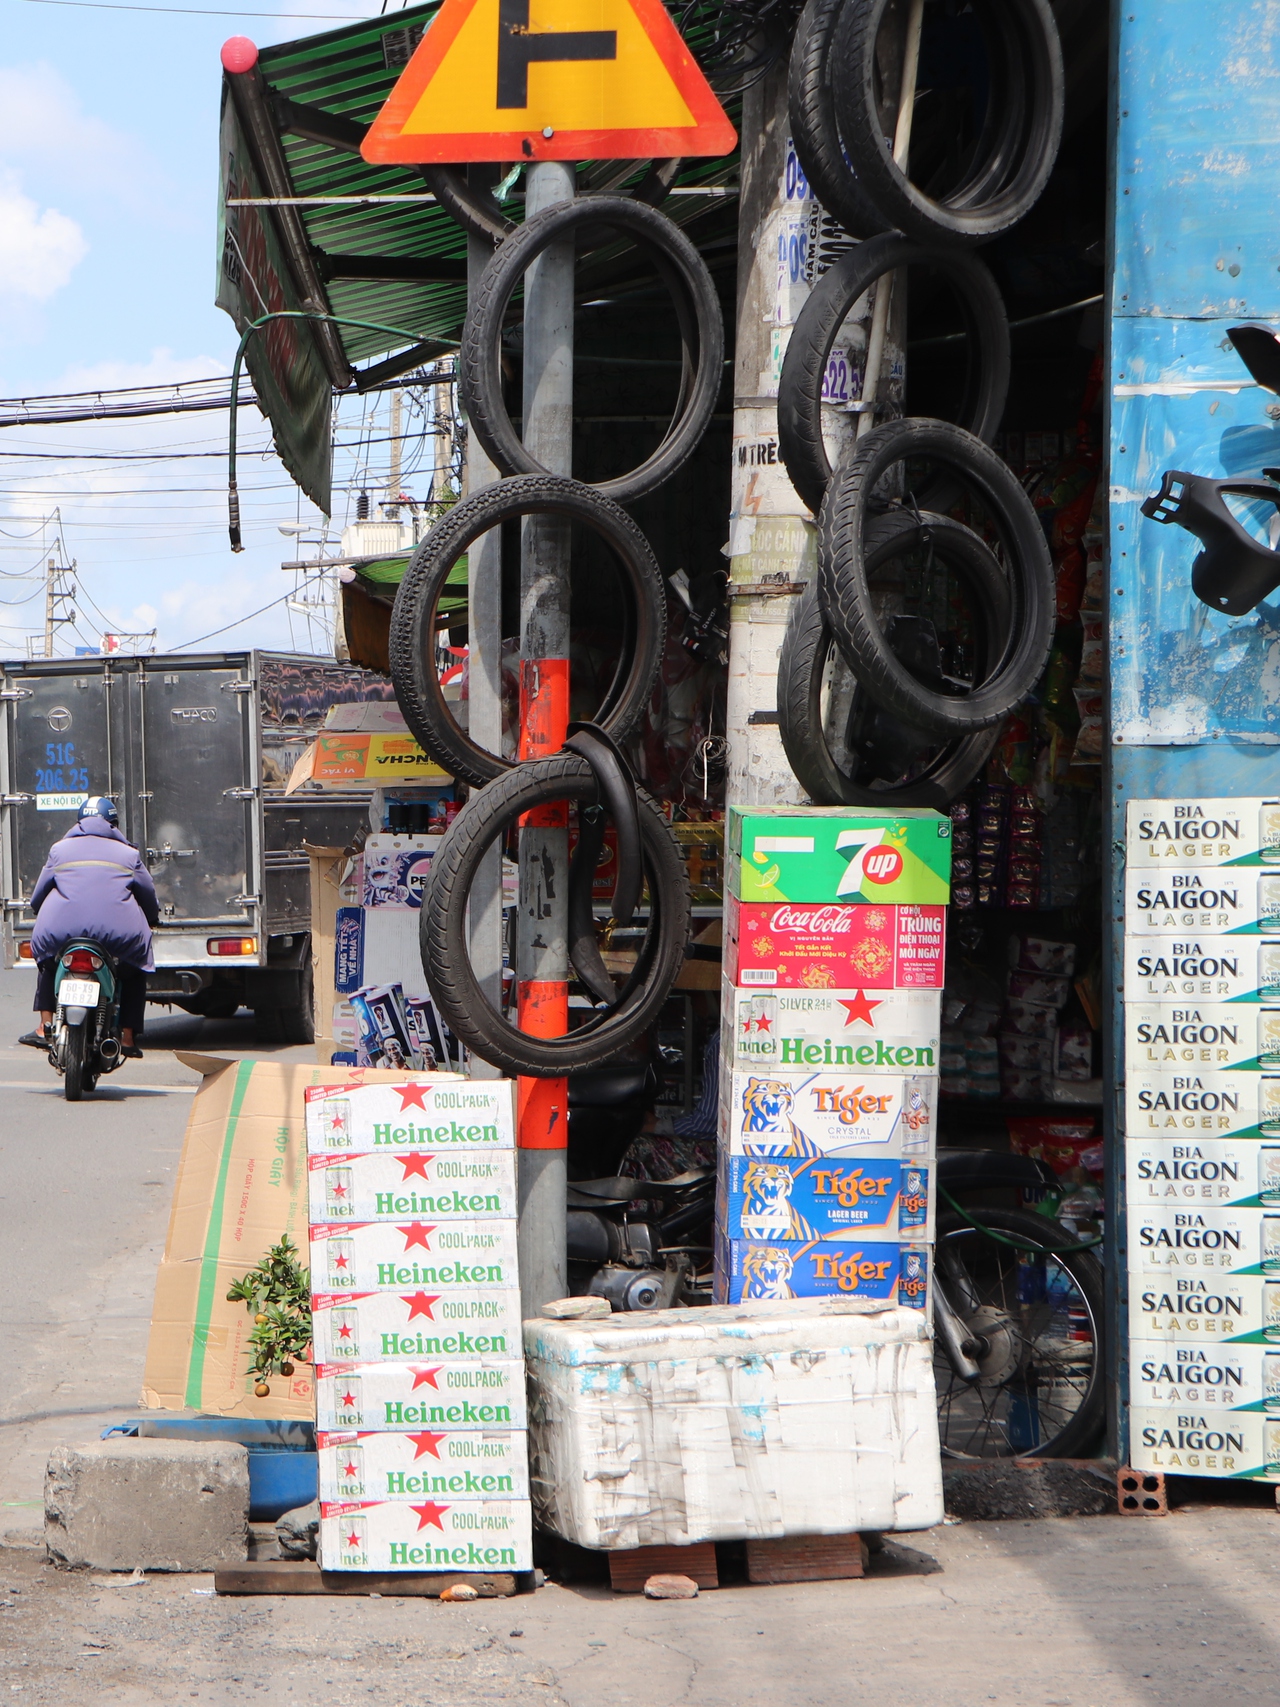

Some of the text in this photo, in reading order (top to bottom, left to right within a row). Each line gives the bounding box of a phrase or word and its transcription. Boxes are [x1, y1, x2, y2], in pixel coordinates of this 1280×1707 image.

[46, 742, 76, 765] 51C
[35, 767, 89, 791] 206.25
[40, 795, 83, 807] XE NỘI BỘ
[1173, 805, 1204, 819] BIA
[1139, 820, 1241, 841] SAIGON
[1148, 843, 1231, 857] LAGER
[1172, 874, 1202, 888] BIA
[1137, 889, 1239, 910] SAIGON
[770, 905, 858, 933] Coca-Cola
[900, 905, 921, 917] CƠ HỘI
[1147, 913, 1229, 927] LAGER
[899, 914, 942, 933] TRÚNG
[347, 936, 358, 960] NHÀ
[899, 932, 940, 946] ĐIỆN THOẠI
[1172, 943, 1203, 956] BIA
[337, 931, 349, 985] MANG TẾT
[918, 945, 941, 959] NGÀY
[1137, 957, 1239, 978] SAIGON
[66, 983, 94, 993] 60-X9
[1147, 980, 1229, 994] LAGER
[780, 998, 826, 1011] SILVER 24
[1137, 1024, 1239, 1045] SAIGON
[780, 1037, 936, 1067] Heineken
[810, 1085, 894, 1125] Tiger
[1138, 1091, 1240, 1112] SAIGON
[373, 1121, 499, 1145] Heineken
[828, 1127, 872, 1135] CRYSTAL
[268, 1126, 290, 1188] HỘP GIẤY
[1137, 1160, 1240, 1182] SAIGON
[810, 1168, 893, 1208] Tiger
[375, 1190, 501, 1214] Heineken
[828, 1210, 869, 1220] LAGER BEER
[1139, 1227, 1242, 1250] SAIGON
[377, 1261, 503, 1285] Heineken
[810, 1251, 892, 1291] Tiger
[442, 1301, 499, 1319] COOLPACK
[1141, 1293, 1245, 1316] SAIGON
[381, 1331, 507, 1355] Heineken
[446, 1370, 503, 1388] COOLPACK
[1141, 1362, 1244, 1387] SAIGON
[384, 1401, 511, 1424] Heineken
[1142, 1428, 1245, 1453] SAIGON
[387, 1470, 513, 1494] Heineken
[389, 1542, 517, 1565] Heineken
